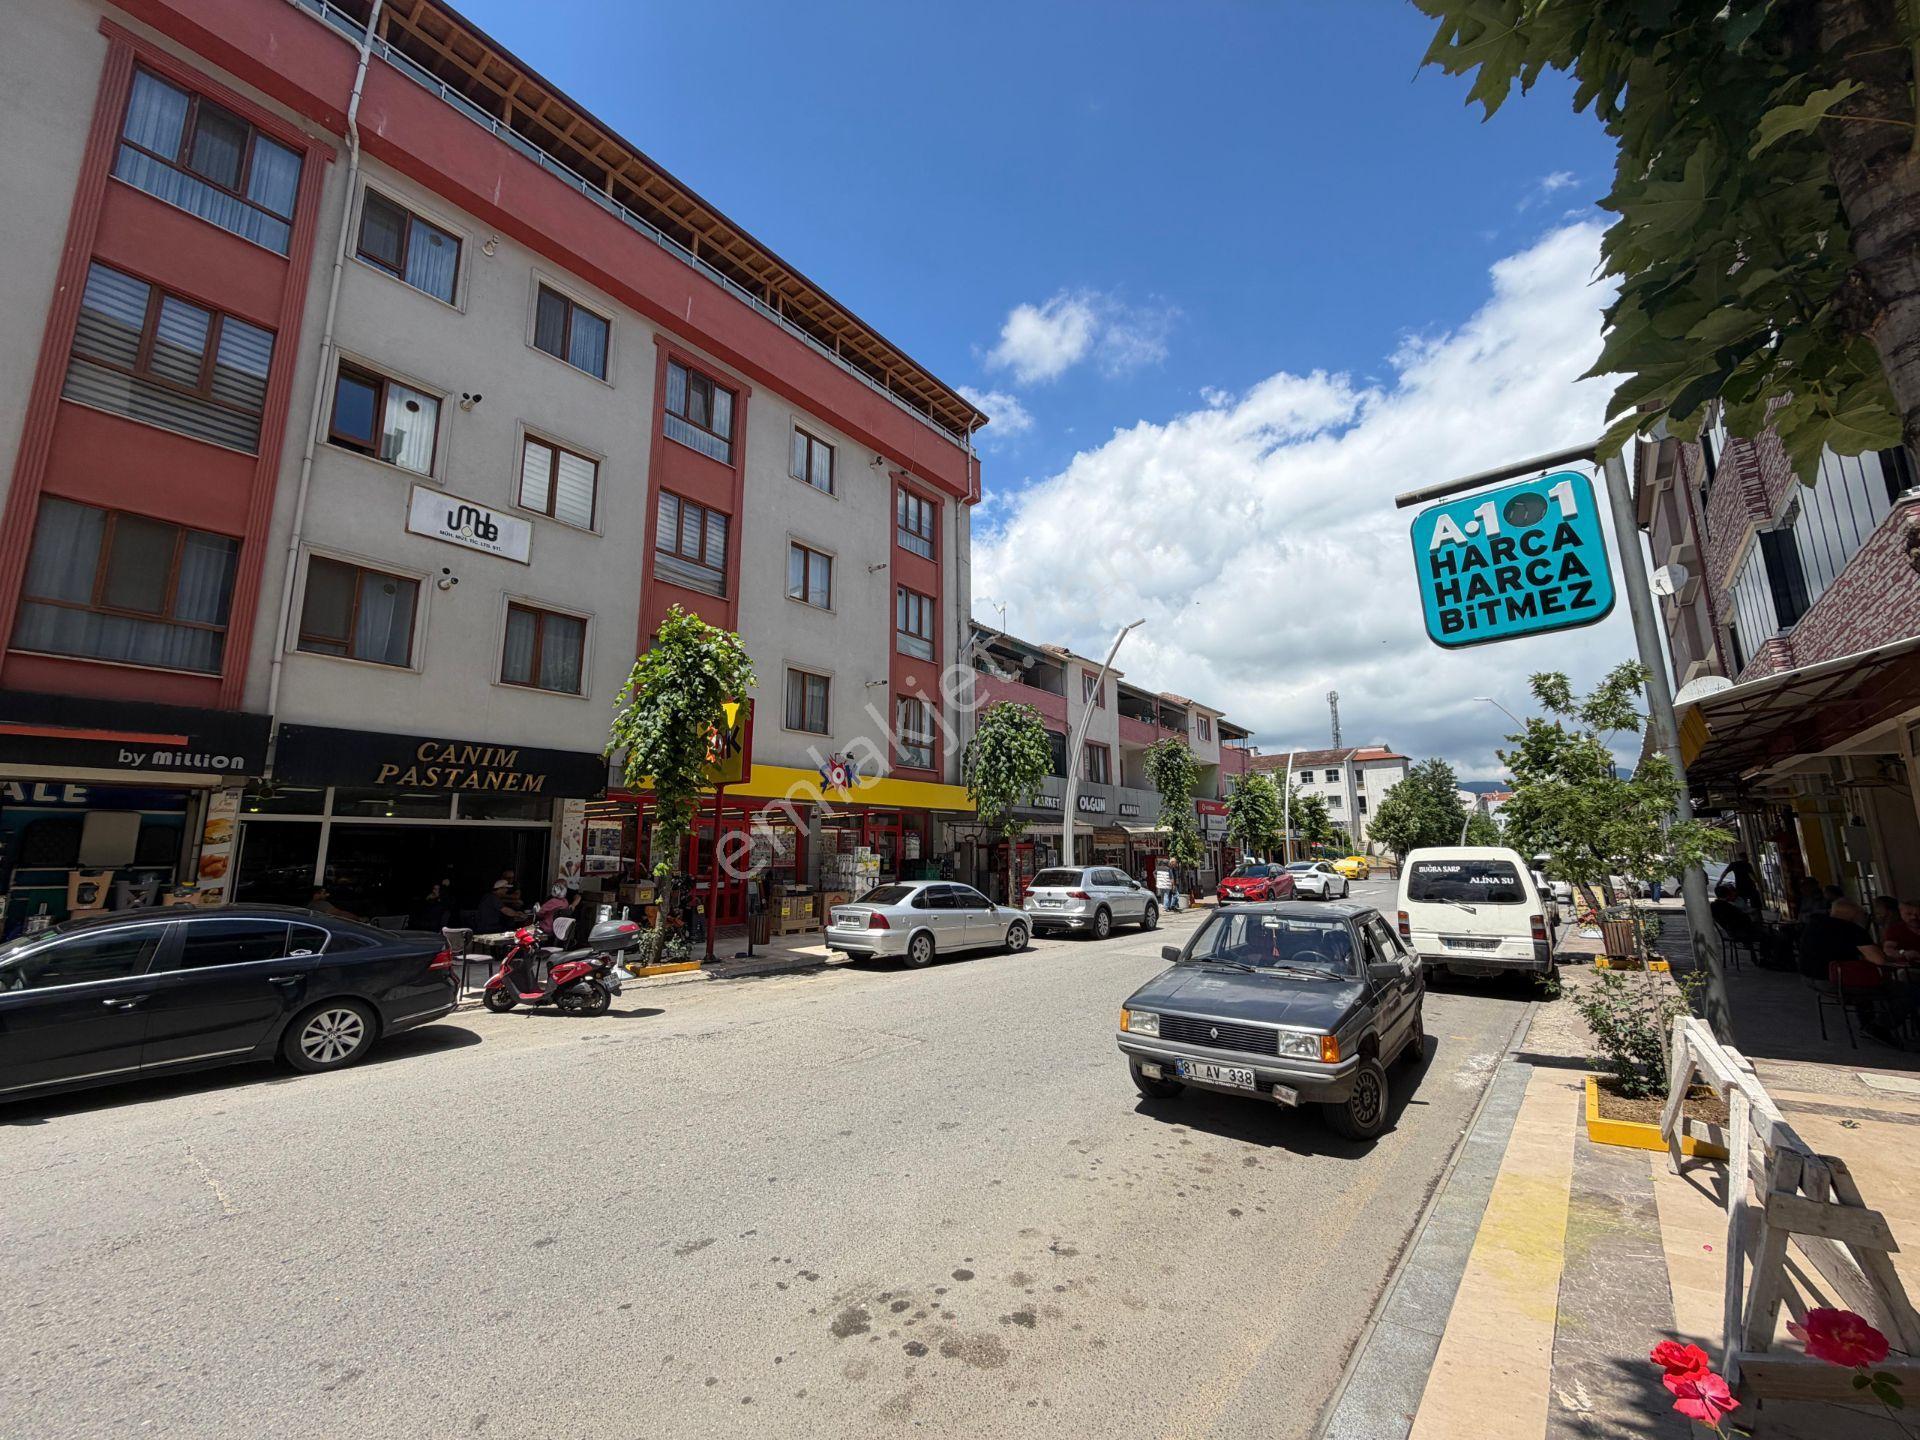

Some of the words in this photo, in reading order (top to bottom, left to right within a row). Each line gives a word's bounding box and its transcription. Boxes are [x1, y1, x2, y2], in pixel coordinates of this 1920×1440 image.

[1430, 522, 1584, 579] HARCA
[1435, 552, 1590, 607] HARCA
[118, 749, 146, 767] by
[416, 742, 519, 768] CANIM
[374, 763, 547, 793] PASTANEM
[1080, 796, 1105, 812] OLGUN
[1419, 864, 1442, 873] BUĞRA
[1469, 875, 1500, 884] ALİNA
[1501, 876, 1514, 885] SU
[1183, 1061, 1198, 1075] 81
[1206, 1065, 1220, 1079] AV
[1228, 1069, 1253, 1085] 338
